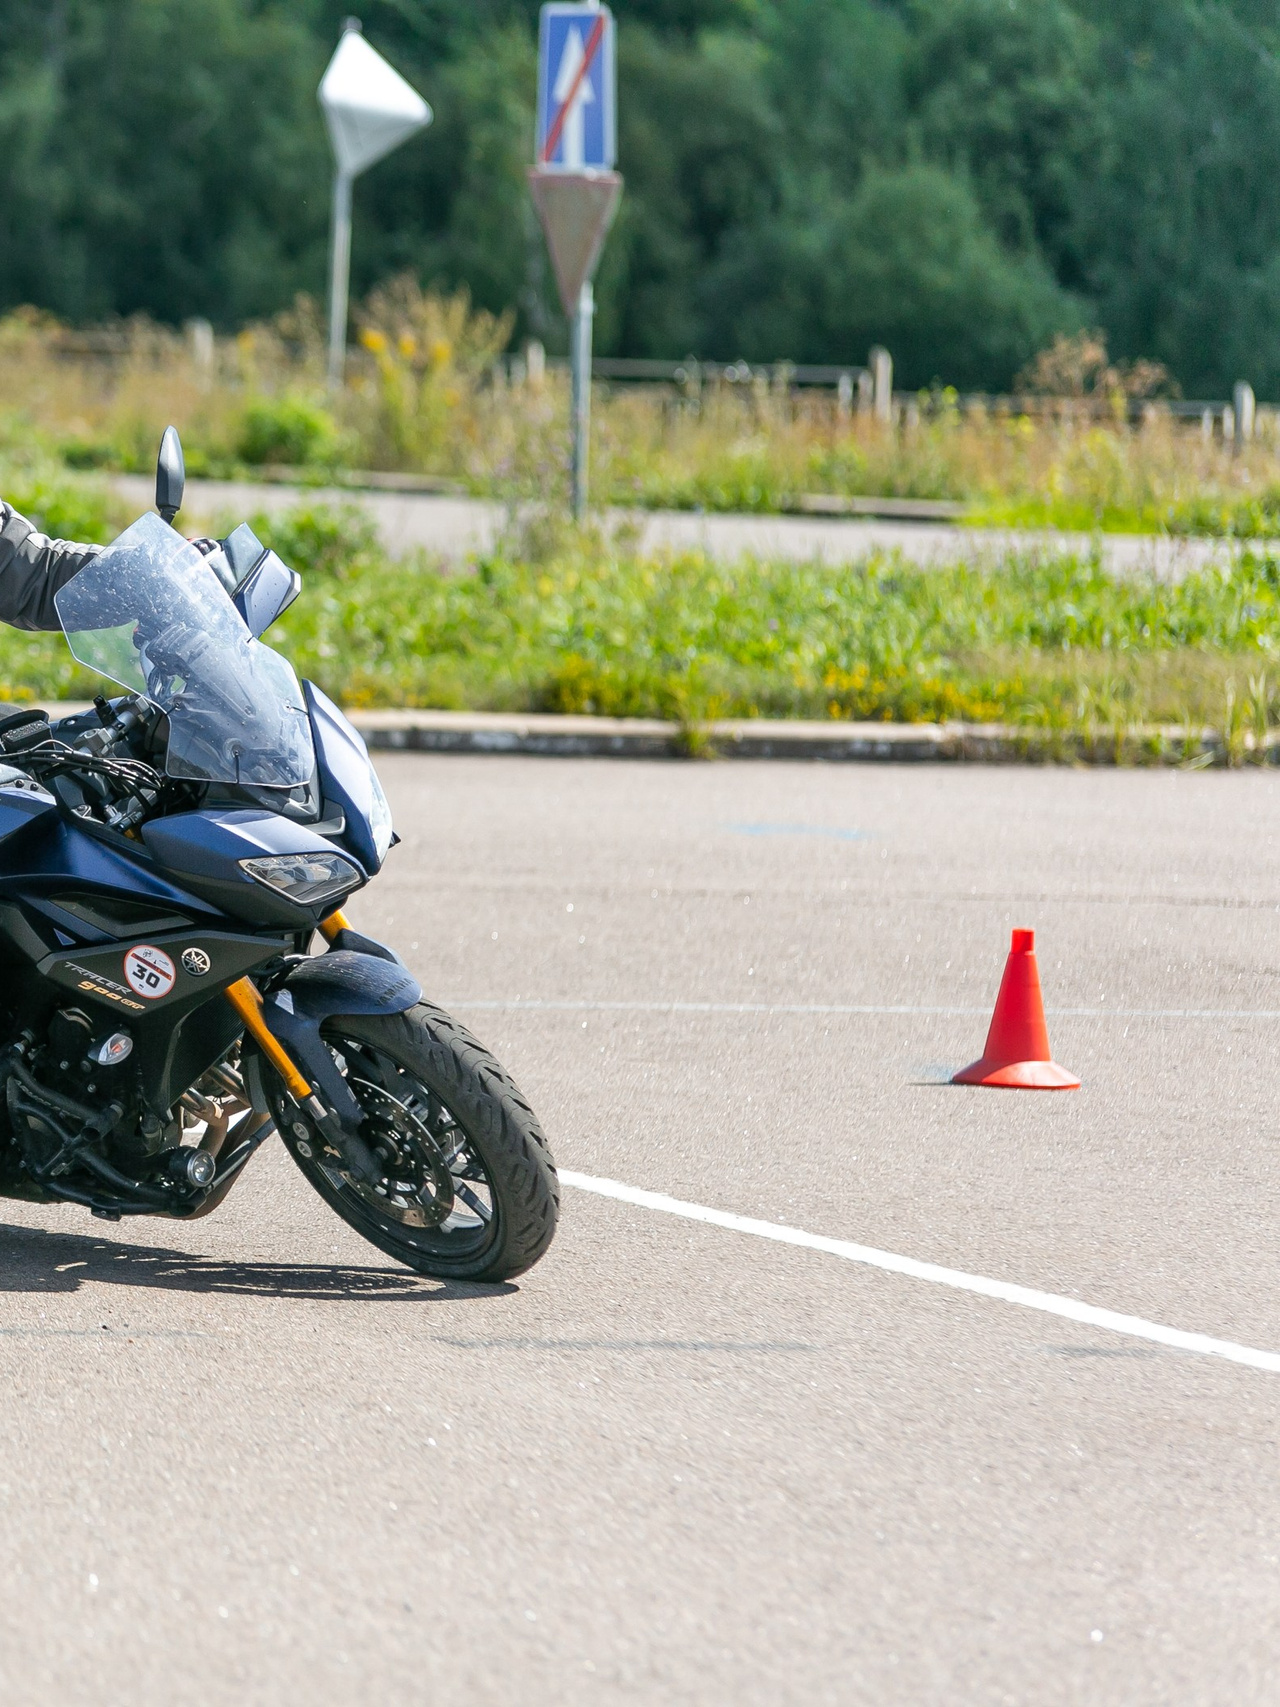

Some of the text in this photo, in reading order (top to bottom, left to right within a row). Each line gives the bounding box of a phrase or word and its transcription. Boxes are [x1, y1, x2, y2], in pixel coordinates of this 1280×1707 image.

[64, 961, 133, 995] TRACER
[131, 963, 161, 989] 30
[77, 980, 123, 1001] 900
[121, 997, 146, 1010] GT
[374, 977, 415, 1007] YAMAHA
